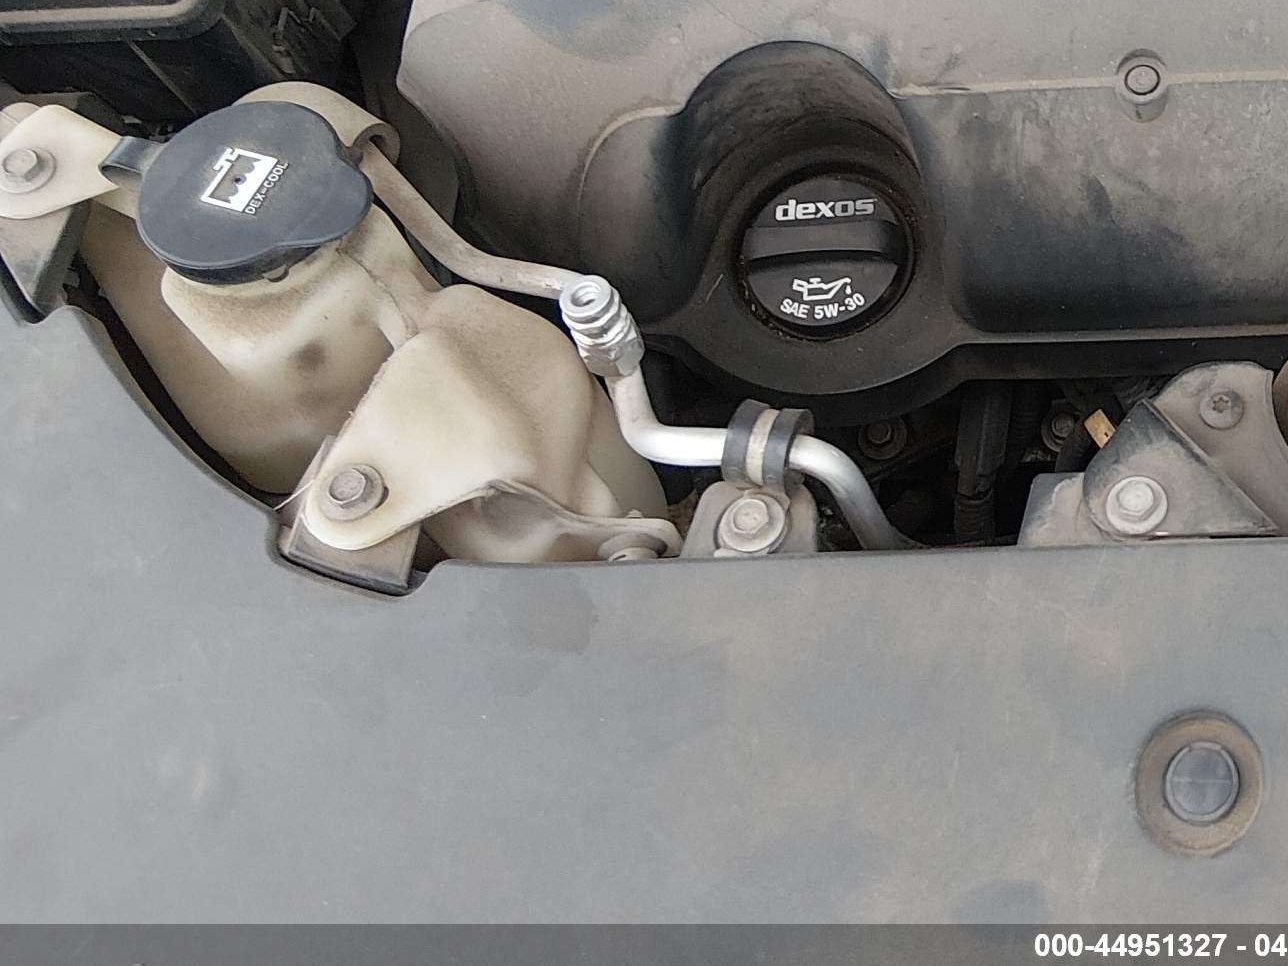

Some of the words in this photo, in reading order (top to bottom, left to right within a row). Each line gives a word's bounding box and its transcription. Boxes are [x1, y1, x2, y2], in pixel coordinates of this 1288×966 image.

[775, 198, 876, 221] dexos
[780, 298, 810, 319] SAE
[814, 292, 865, 320] 5W-30
